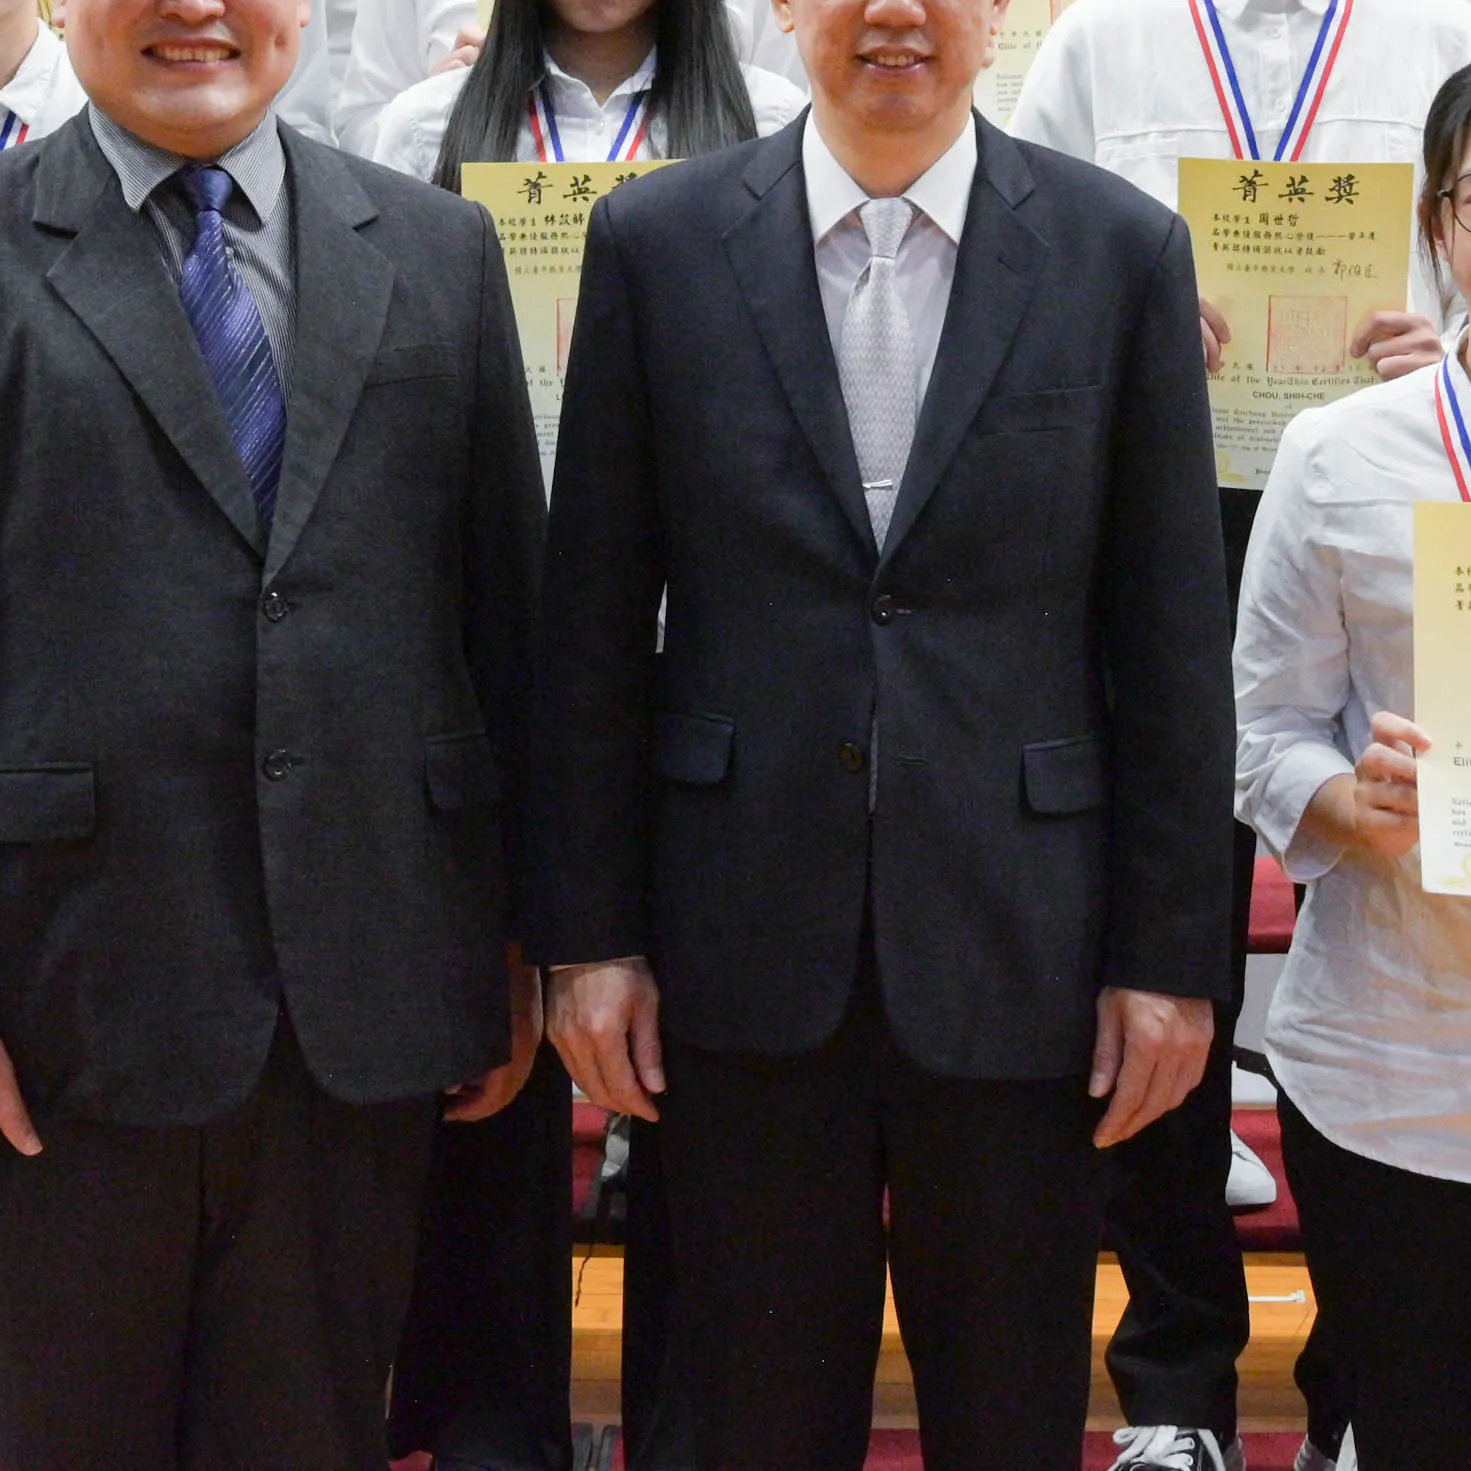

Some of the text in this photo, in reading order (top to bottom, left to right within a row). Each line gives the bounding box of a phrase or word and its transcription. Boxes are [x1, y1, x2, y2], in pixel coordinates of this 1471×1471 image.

[517, 172, 638, 204] 菁英
[1232, 169, 1359, 204] 菁英獎
